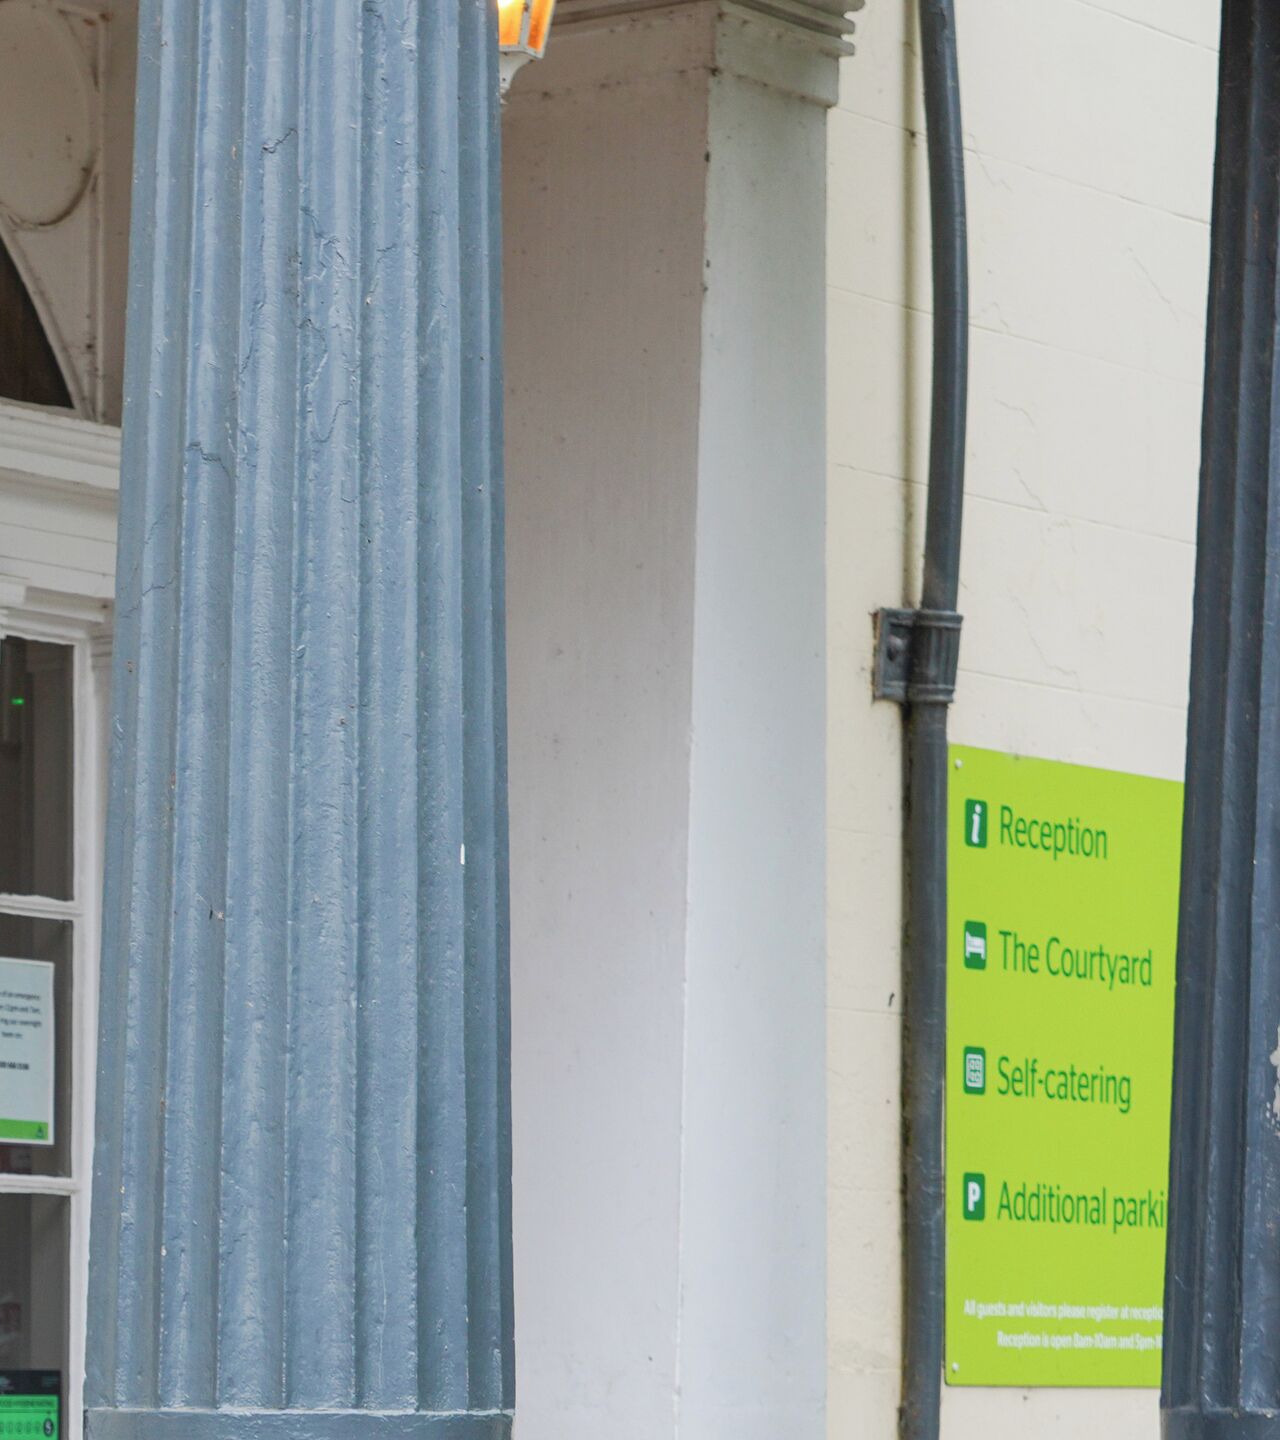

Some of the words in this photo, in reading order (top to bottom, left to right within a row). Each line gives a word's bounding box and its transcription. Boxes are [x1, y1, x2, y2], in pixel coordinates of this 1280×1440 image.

[999, 804, 1108, 861] Reception
[998, 929, 1040, 974] The
[1045, 936, 1153, 991] Courtyard
[996, 1055, 1132, 1114] Self-catering
[997, 1180, 1107, 1226] Additional
[997, 1330, 1041, 1350] Reception
